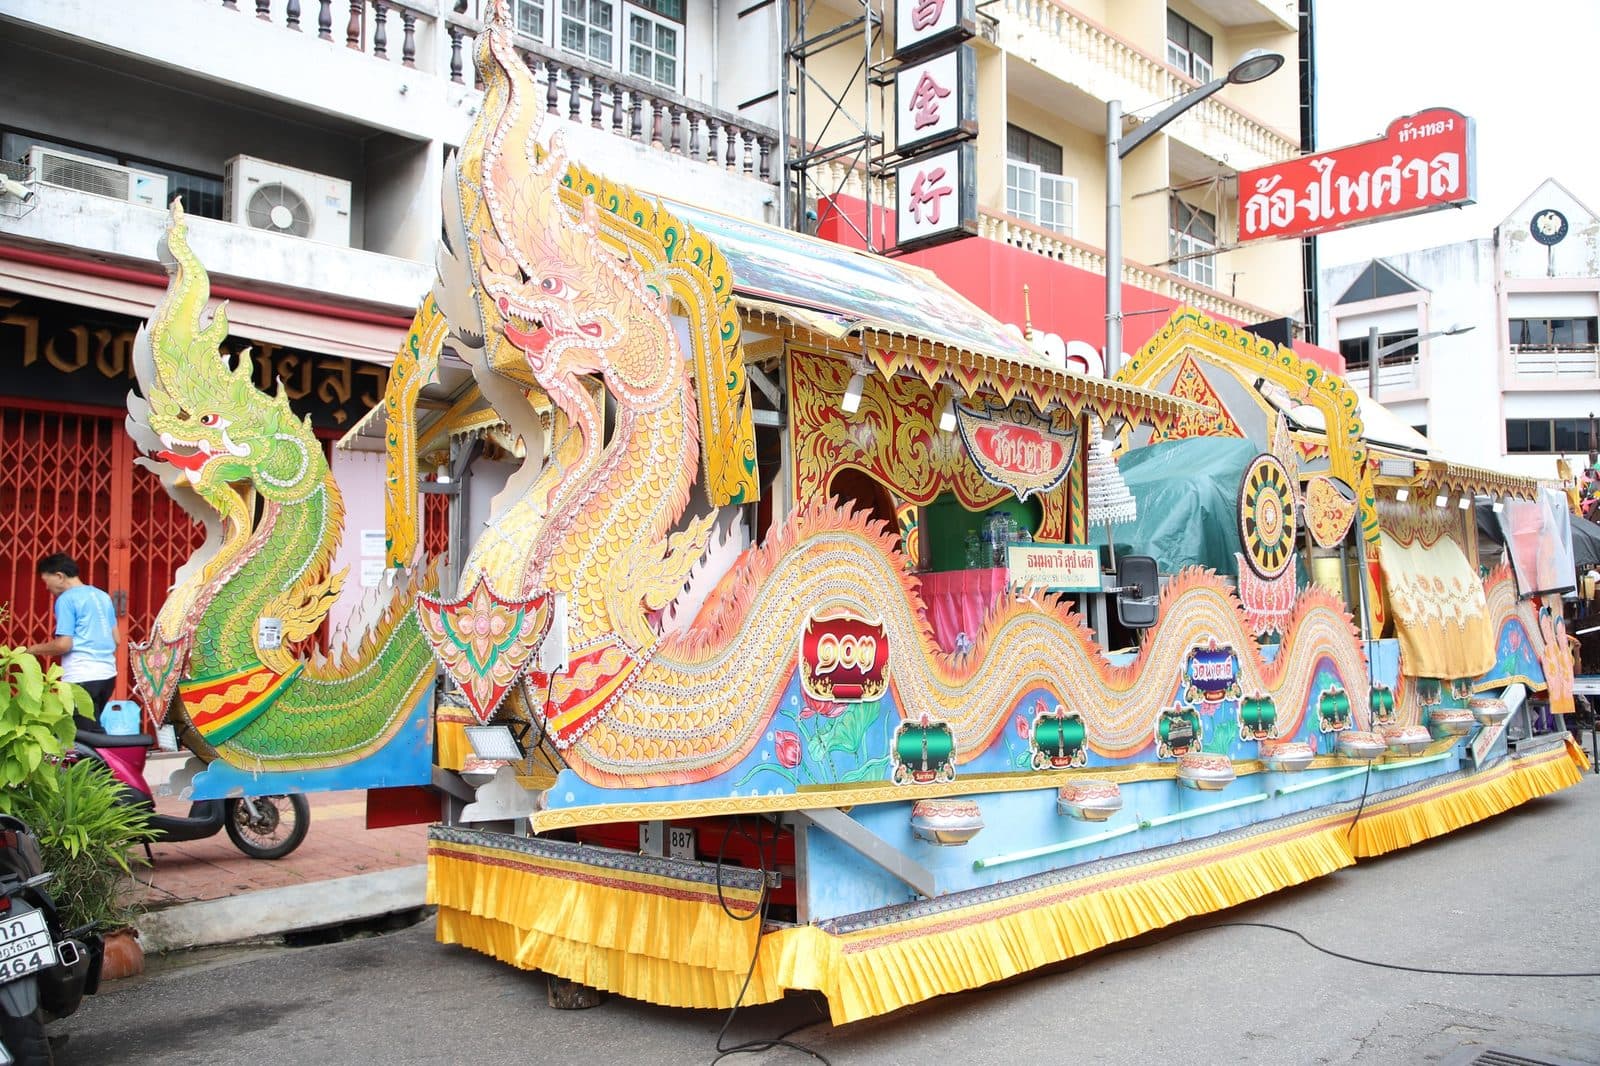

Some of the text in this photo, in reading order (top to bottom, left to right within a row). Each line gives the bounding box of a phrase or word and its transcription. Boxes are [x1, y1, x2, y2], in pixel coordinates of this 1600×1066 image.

[1398, 118, 1454, 143] ห้างทอง
[1244, 151, 1460, 234] ก้องไพศาล
